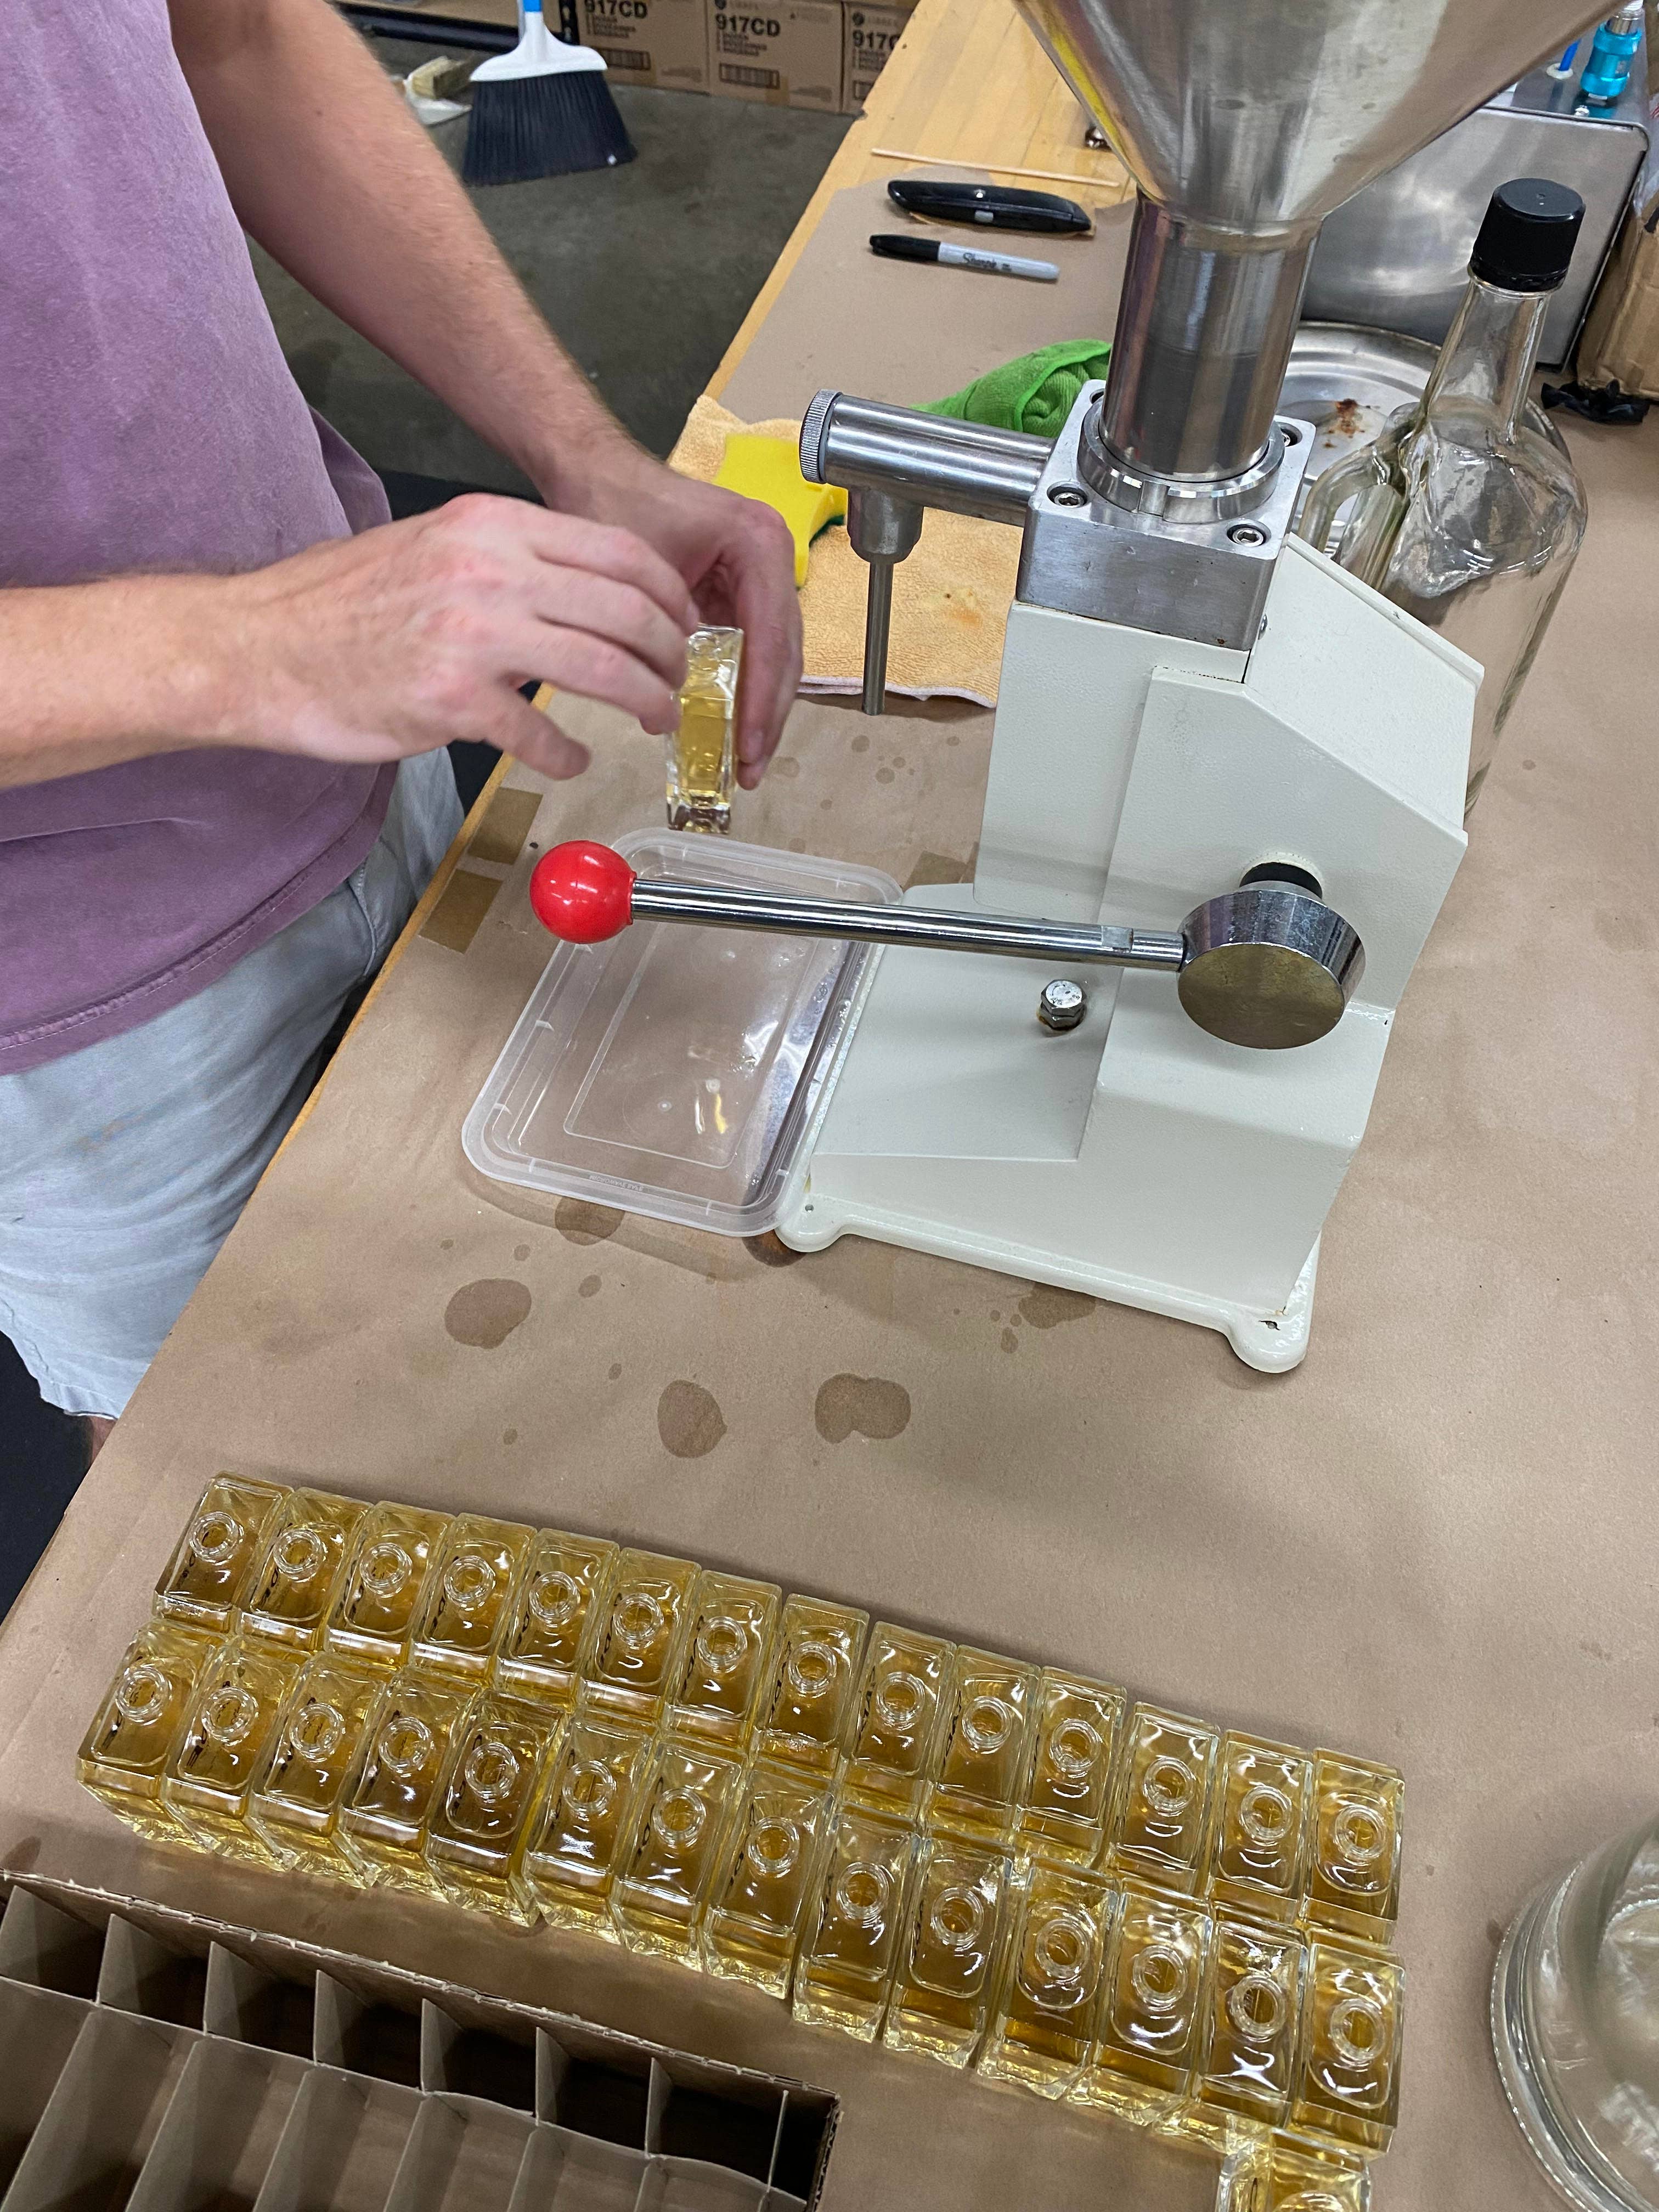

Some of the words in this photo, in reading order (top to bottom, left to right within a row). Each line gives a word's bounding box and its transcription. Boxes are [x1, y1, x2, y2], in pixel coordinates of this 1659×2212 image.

[585, 0, 647, 19] 917CD
[715, 13, 781, 37] 917CD
[853, 30, 900, 50] 917C
